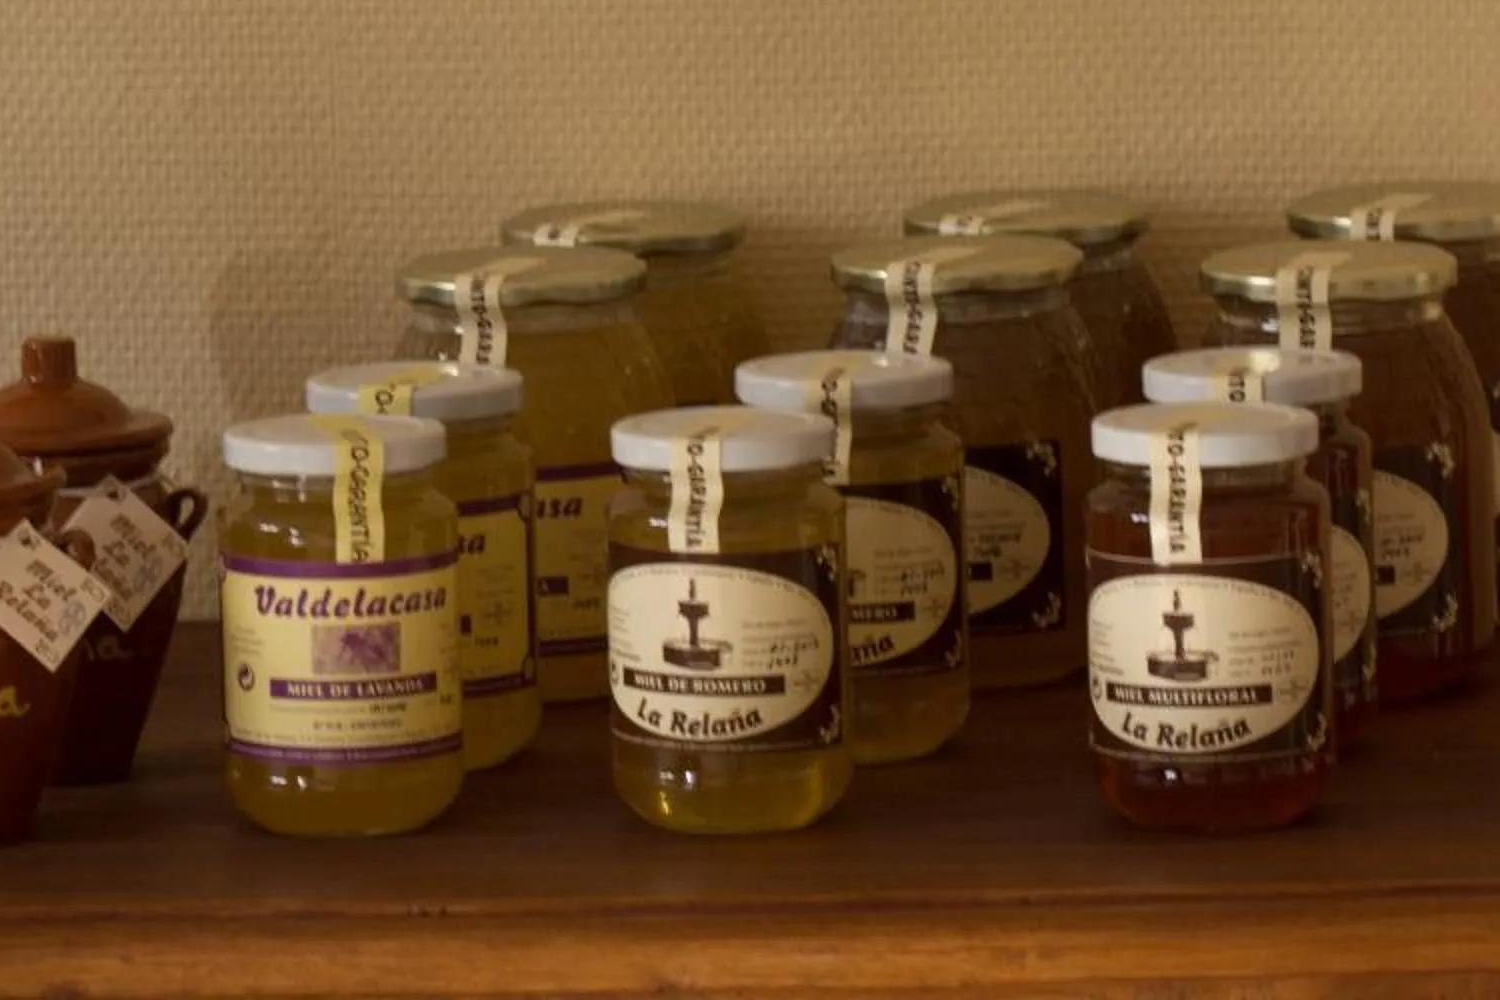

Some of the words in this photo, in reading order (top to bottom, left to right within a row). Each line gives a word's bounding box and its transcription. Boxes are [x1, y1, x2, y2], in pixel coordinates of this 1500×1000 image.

[254, 584, 447, 619] Valdelacasa
[636, 696, 663, 728] La
[669, 707, 763, 738] Relaña
[1121, 710, 1148, 742] La
[1156, 716, 1253, 748] Relaña
